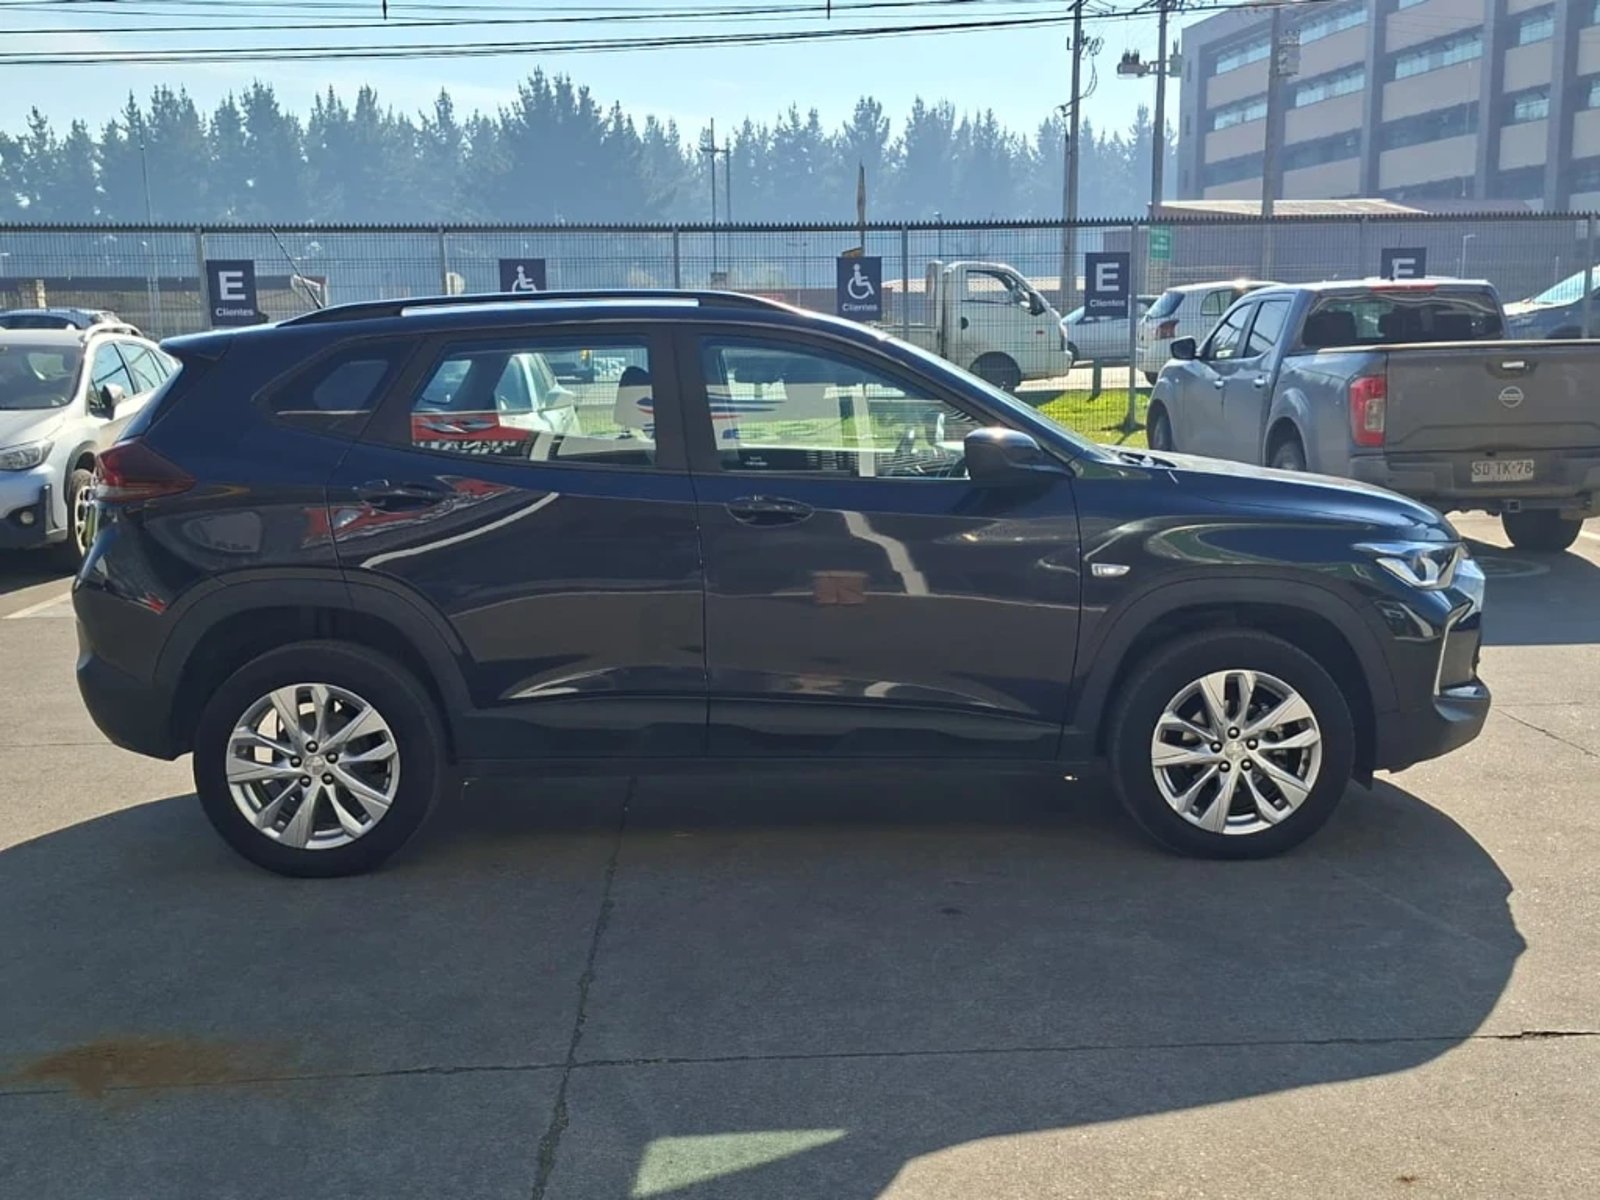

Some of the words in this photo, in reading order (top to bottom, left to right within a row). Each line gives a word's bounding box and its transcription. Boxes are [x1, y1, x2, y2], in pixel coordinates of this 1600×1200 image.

[1096, 262, 1120, 291] E
[218, 271, 246, 301] E
[842, 303, 878, 313] Clientes
[1089, 299, 1126, 308] Clientes
[215, 307, 255, 317] Clientes
